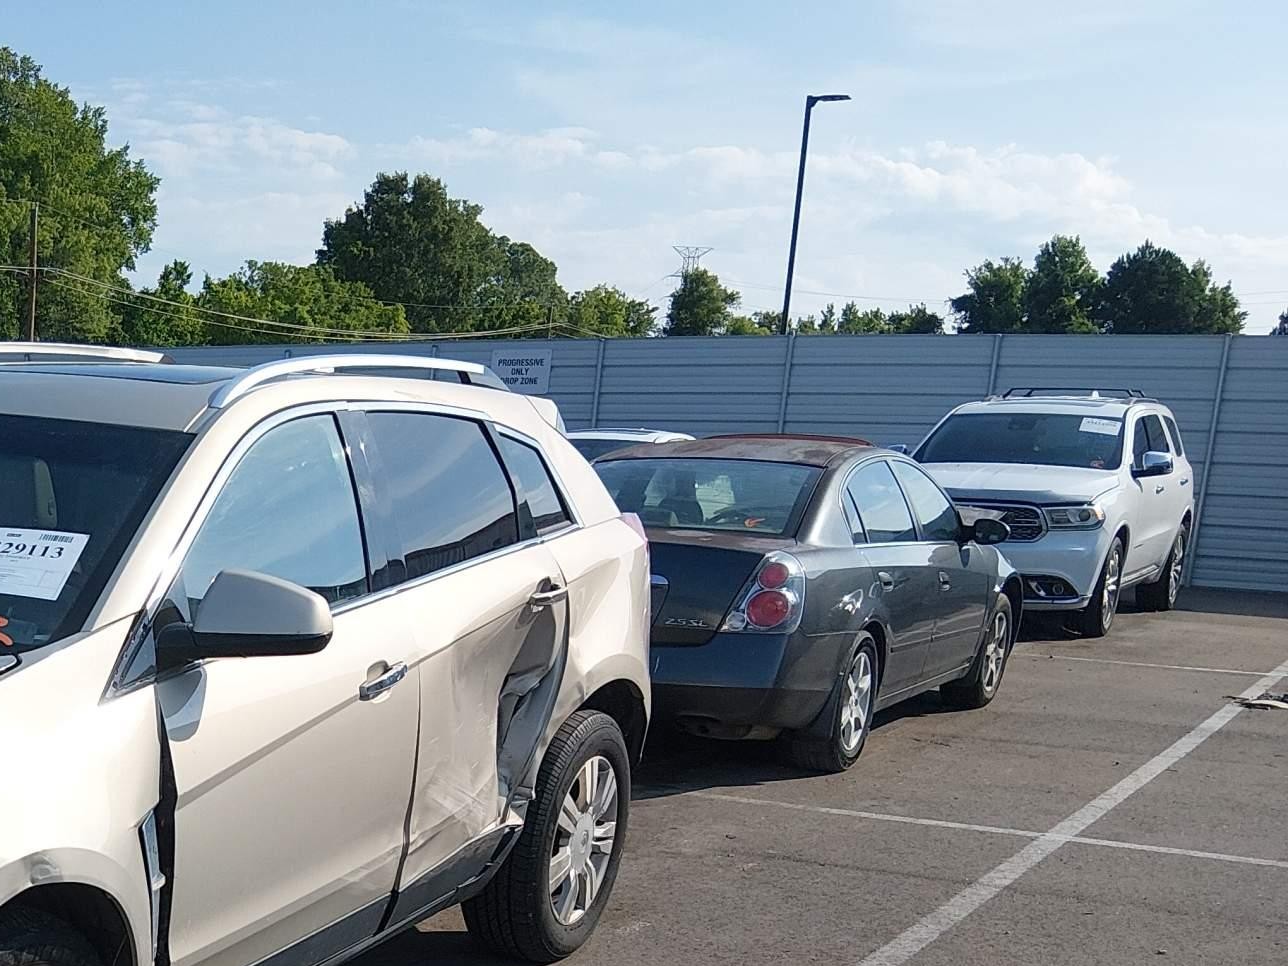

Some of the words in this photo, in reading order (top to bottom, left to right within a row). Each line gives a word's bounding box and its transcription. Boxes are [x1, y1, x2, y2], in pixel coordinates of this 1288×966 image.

[497, 358, 545, 367] PROGRESSIVE
[511, 367, 530, 376] ONLY
[520, 377, 538, 385] ZONE
